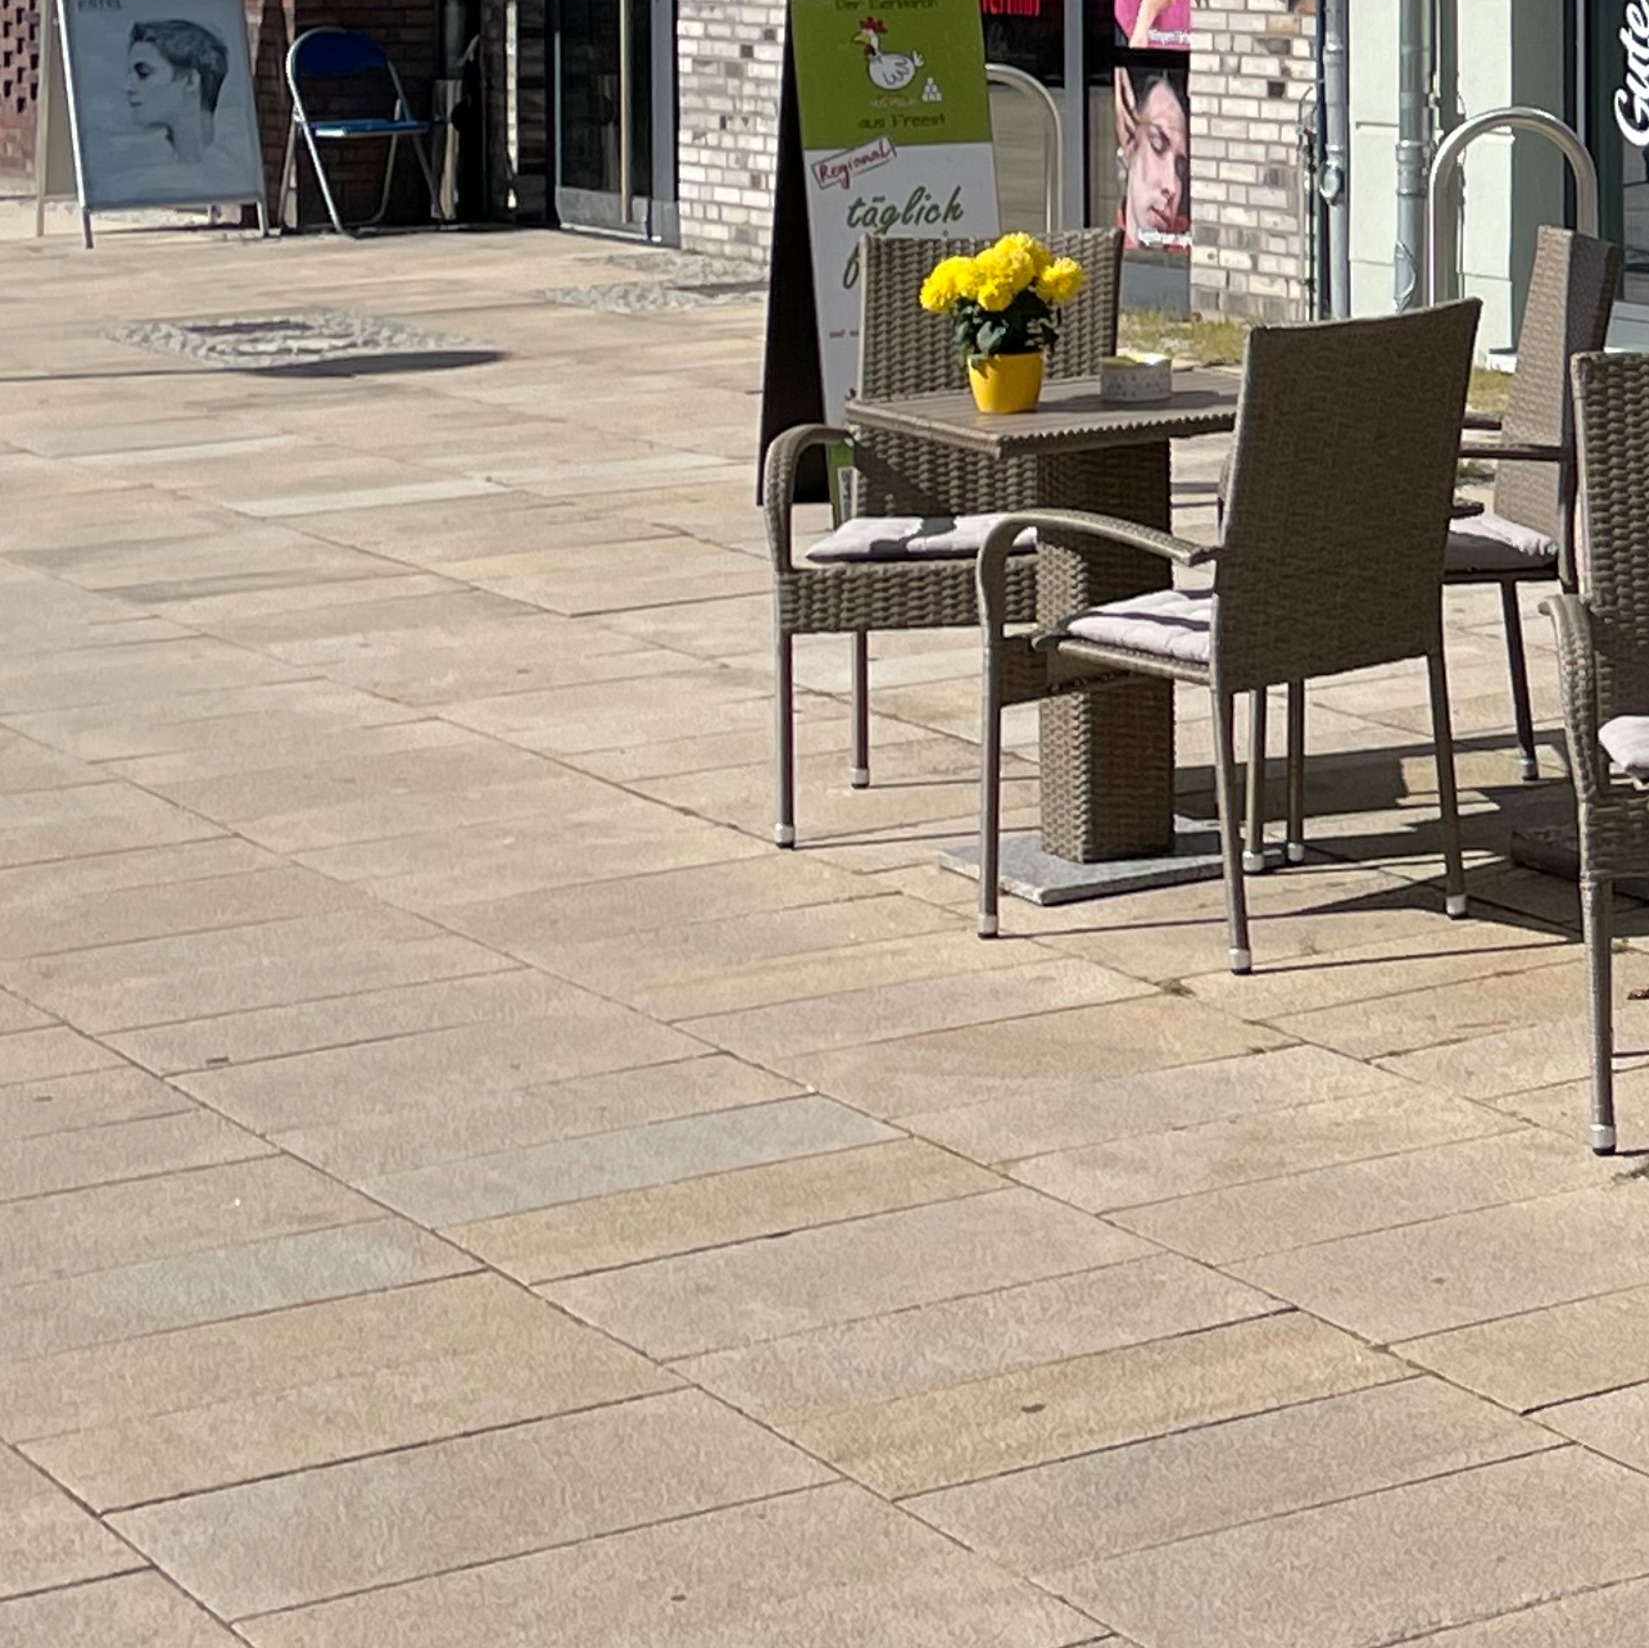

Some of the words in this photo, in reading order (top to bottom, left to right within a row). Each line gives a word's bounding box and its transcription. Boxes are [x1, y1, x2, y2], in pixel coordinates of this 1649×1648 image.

[858, 117, 885, 130] aus
[817, 136, 892, 190] Regional
[846, 185, 964, 235] täglich
